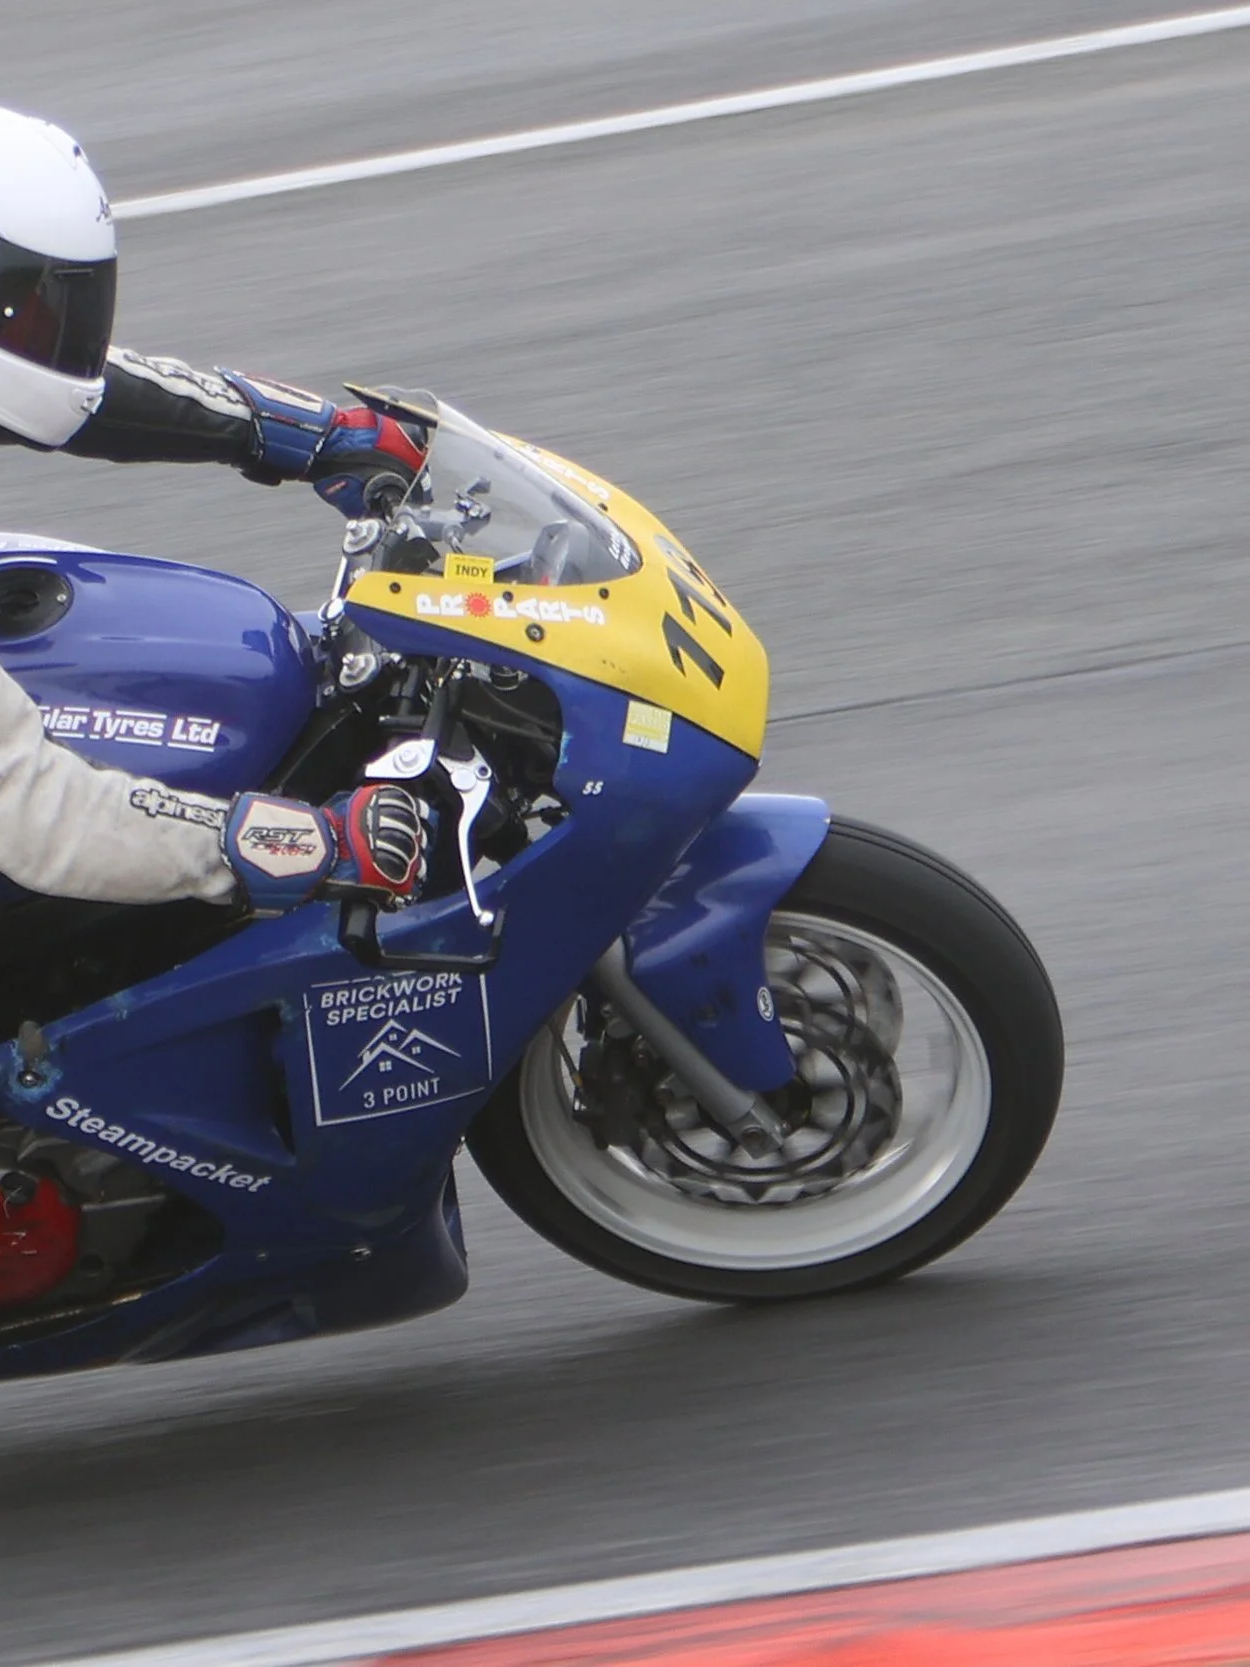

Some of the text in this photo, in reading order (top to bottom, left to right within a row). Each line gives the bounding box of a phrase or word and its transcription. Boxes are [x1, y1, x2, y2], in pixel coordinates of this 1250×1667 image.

[455, 564, 488, 578] INDY
[493, 596, 605, 626] PARTS
[92, 711, 166, 739] Tyres
[171, 717, 221, 745] Ltd
[241, 826, 315, 843] RST
[321, 972, 463, 1009] BRICKWORK
[326, 988, 462, 1026] SPECIALIST
[363, 1077, 441, 1109] 3 POINT
[46, 1097, 272, 1192] Steampacket
